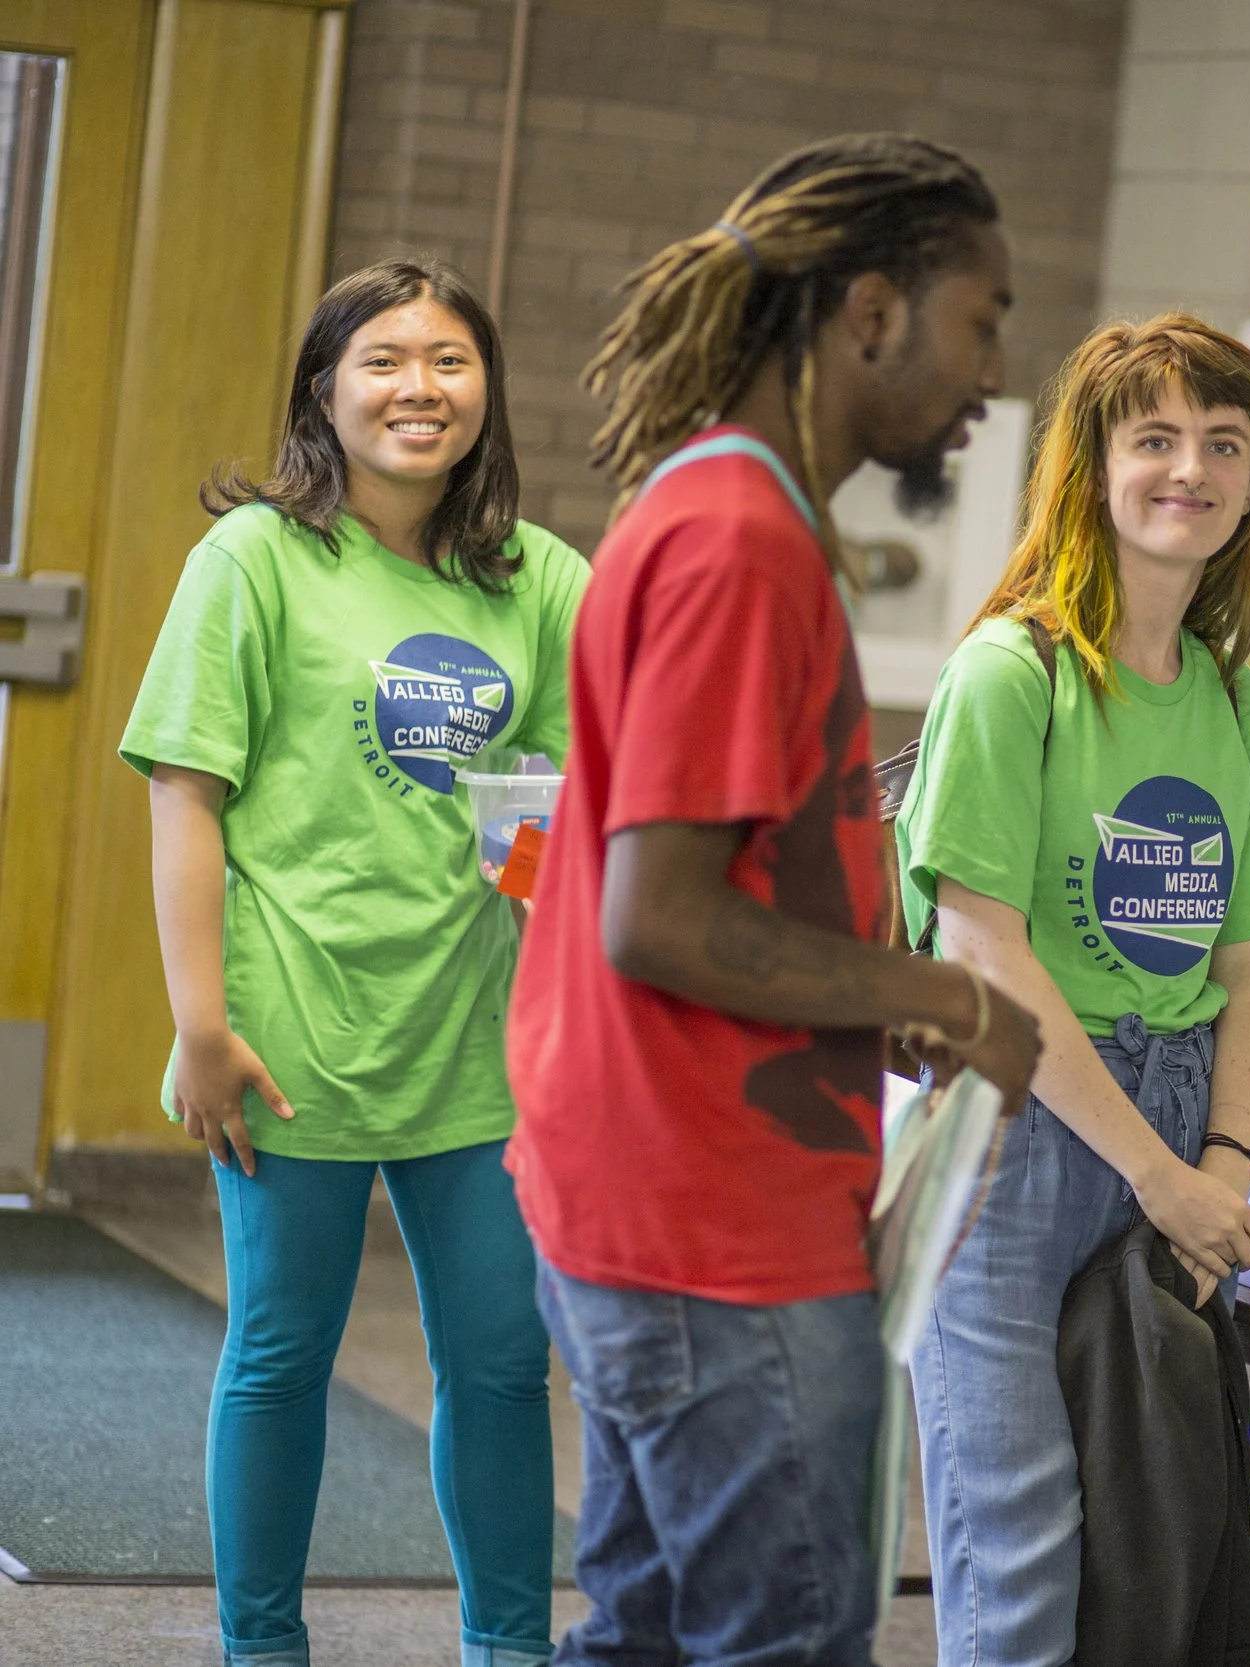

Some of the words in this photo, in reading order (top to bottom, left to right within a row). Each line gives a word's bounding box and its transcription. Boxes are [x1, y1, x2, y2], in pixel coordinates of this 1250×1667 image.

[461, 666, 503, 679] ANNUAL
[393, 682, 466, 704] ALLIED
[353, 700, 414, 797] DETROIT
[1166, 812, 1184, 824] 17TH
[1188, 815, 1222, 825] ANNUAL
[1116, 844, 1183, 865] ALLIED
[1165, 872, 1218, 893] MEDIA
[1065, 855, 1124, 972] DETROIT
[1109, 896, 1226, 919] CONFERENCE
